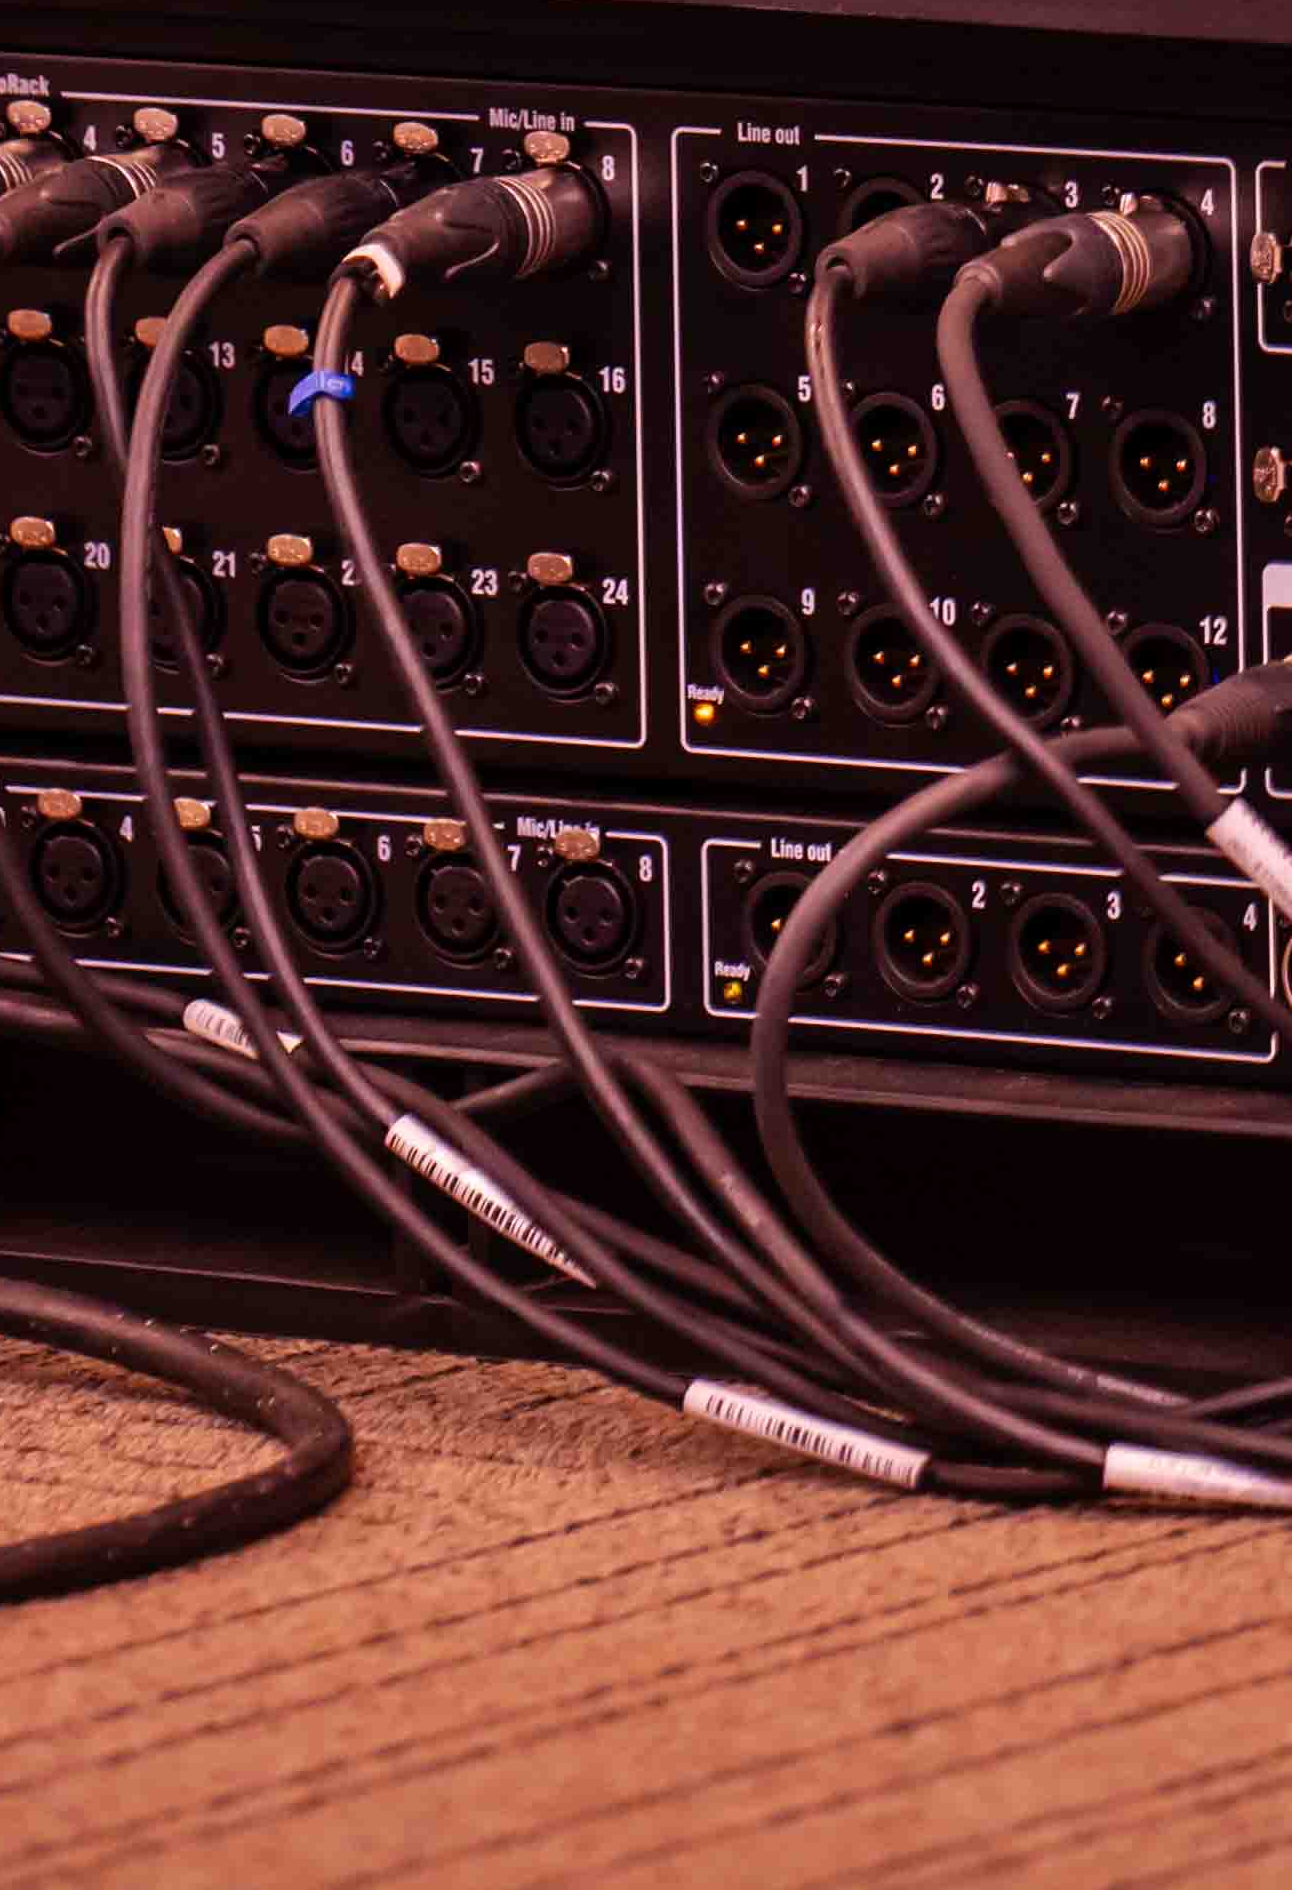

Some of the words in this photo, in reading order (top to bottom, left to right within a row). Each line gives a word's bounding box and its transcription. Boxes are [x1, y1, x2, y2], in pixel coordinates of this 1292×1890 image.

[489, 108, 556, 134] Mic/Line
[561, 112, 574, 131] in
[738, 123, 771, 143] Line
[775, 126, 800, 145] out
[84, 126, 96, 151] 4
[212, 133, 225, 159] 5
[341, 140, 354, 166] 6
[471, 148, 483, 173] 7
[602, 155, 615, 181] 8
[797, 166, 807, 191] 1
[931, 174, 943, 199] 2
[1065, 181, 1078, 208] 3
[1201, 189, 1214, 216] 4
[209, 342, 235, 368] 13
[468, 359, 494, 385] 15
[599, 367, 625, 393] 16
[798, 376, 811, 401] 5
[932, 384, 945, 410] 6
[1066, 393, 1079, 419] 7
[1203, 401, 1216, 428] 8
[84, 542, 110, 569] 20
[213, 551, 235, 577] 21
[472, 569, 498, 595] 23
[603, 578, 628, 605] 24
[802, 589, 814, 615] 9
[930, 597, 955, 625] 10
[1200, 616, 1226, 645] 12
[688, 685, 724, 705] Ready
[120, 816, 133, 841] 4
[378, 835, 391, 861] 6
[508, 845, 520, 871] 7
[771, 838, 803, 859] Line
[807, 843, 835, 866] out
[640, 856, 652, 881] 8
[972, 881, 985, 908] 2
[1108, 892, 1120, 919] 3
[1244, 903, 1256, 931] 4
[715, 963, 750, 982] Ready
